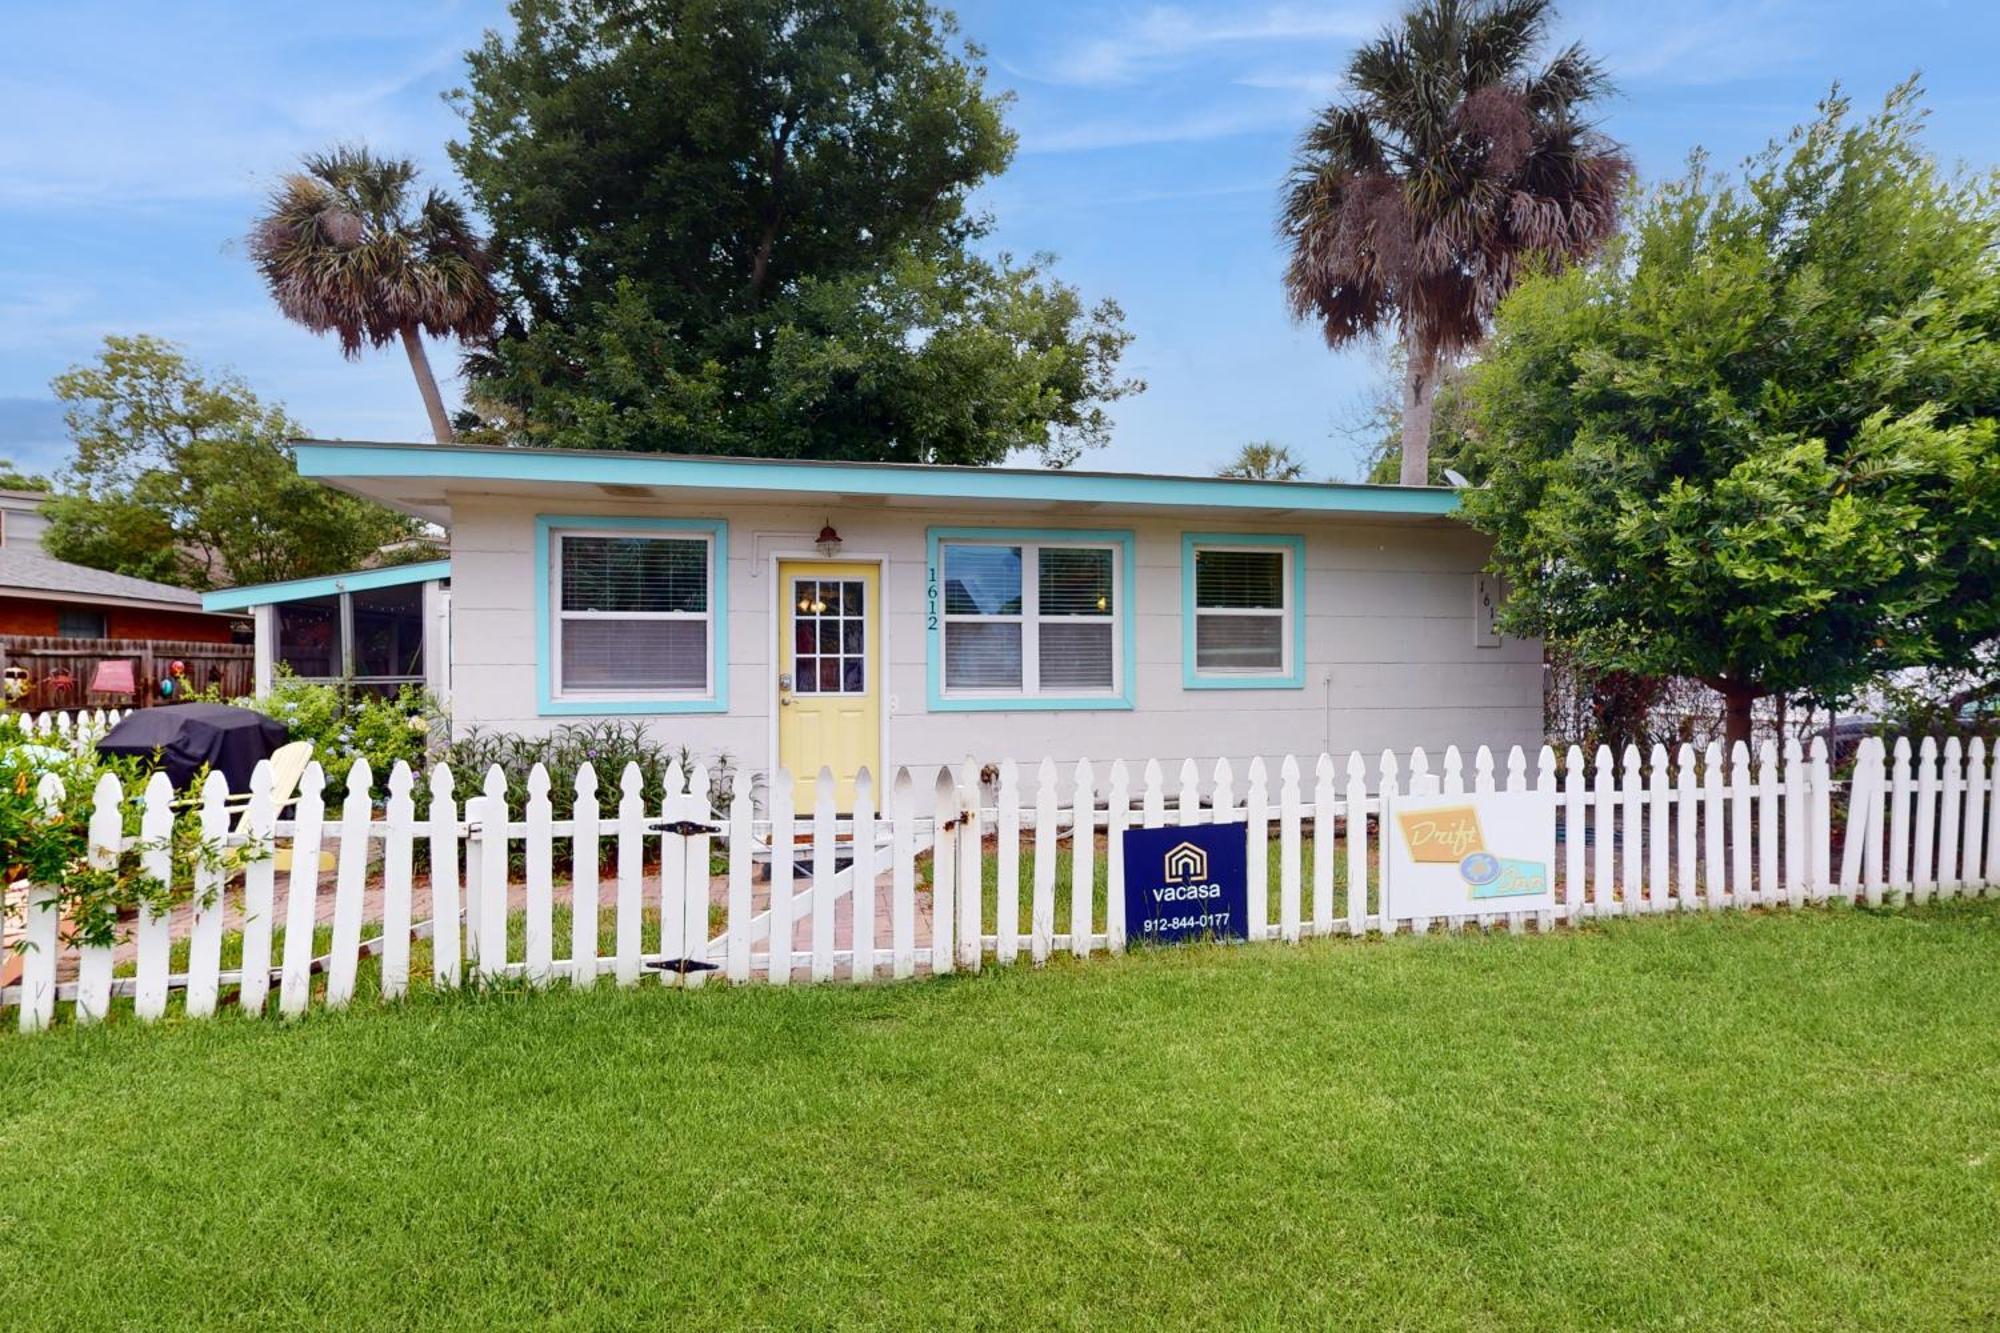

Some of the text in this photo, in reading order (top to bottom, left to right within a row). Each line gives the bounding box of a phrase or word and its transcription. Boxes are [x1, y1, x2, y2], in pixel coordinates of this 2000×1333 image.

[927, 567, 938, 631] 1612
[1411, 817, 1477, 857] Drift
[1152, 883, 1221, 903] vacasa
[1143, 912, 1231, 933] 912-844-0177
